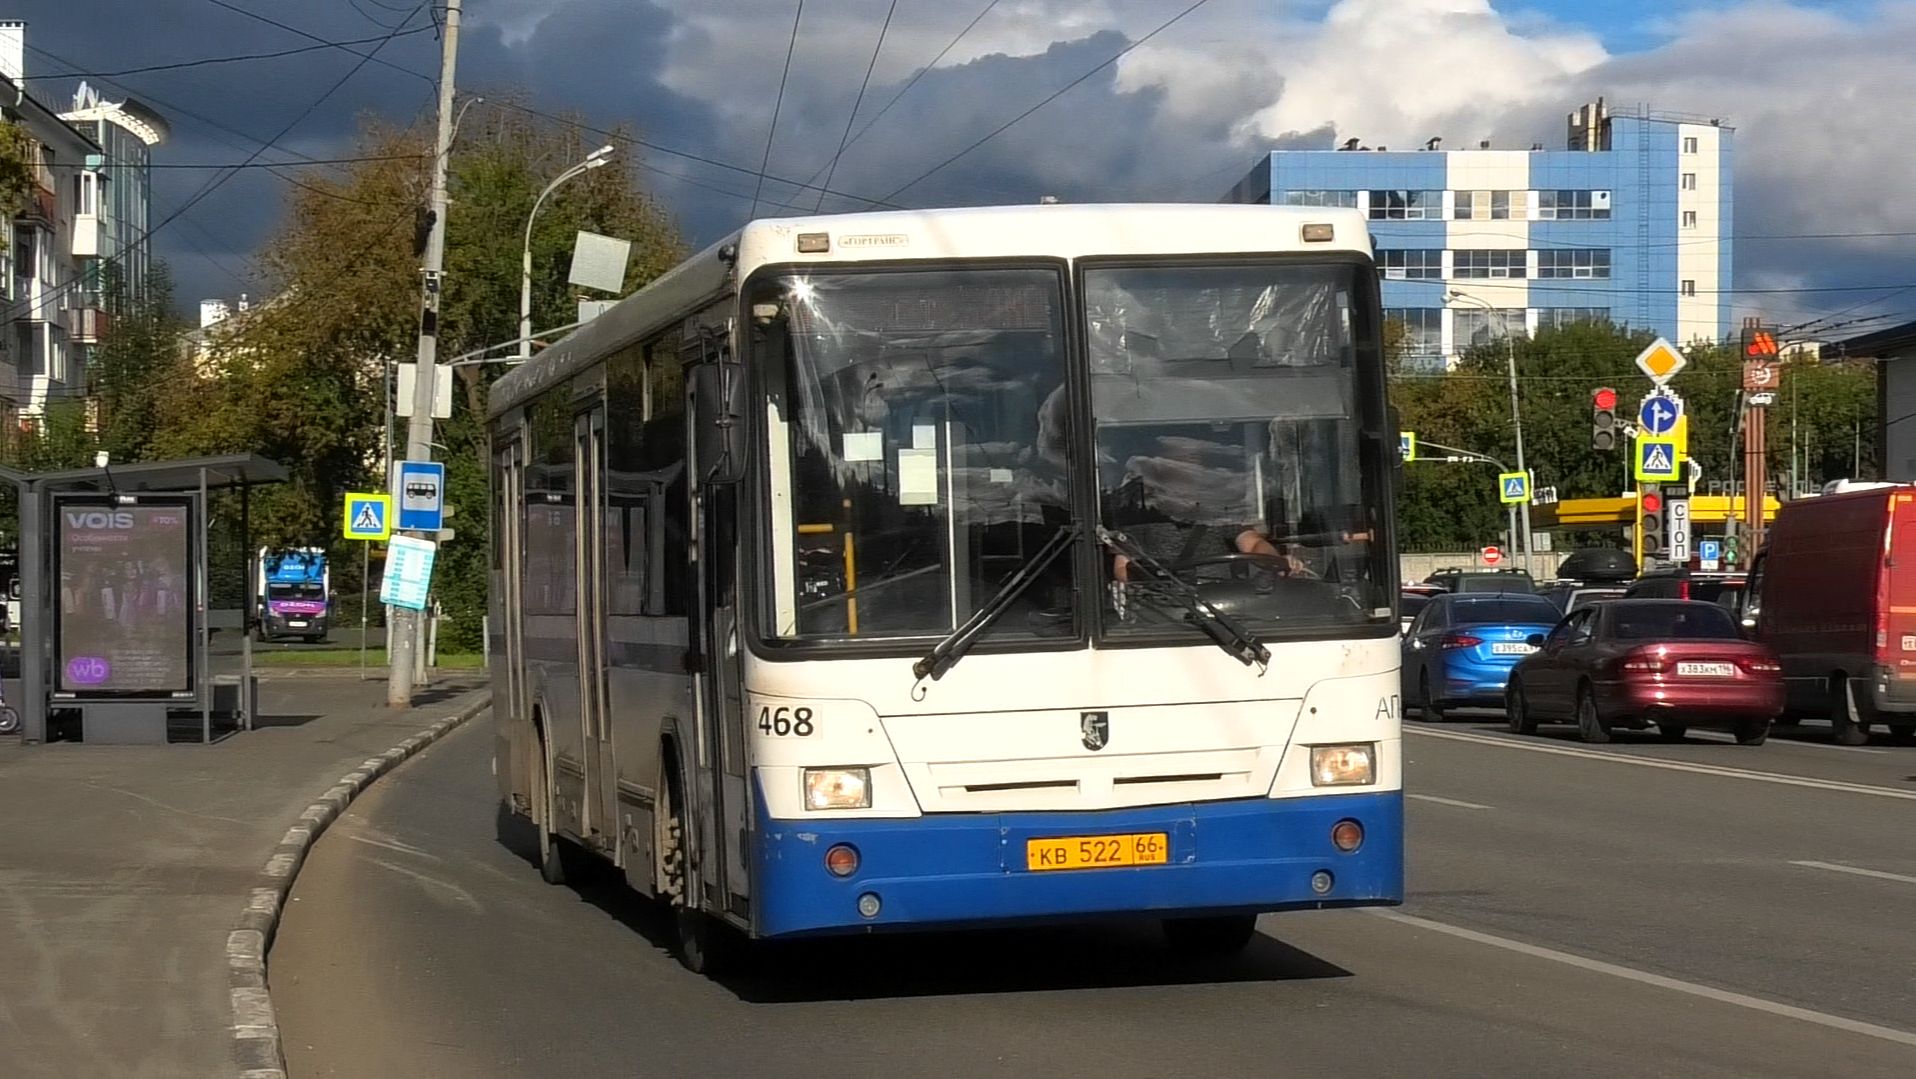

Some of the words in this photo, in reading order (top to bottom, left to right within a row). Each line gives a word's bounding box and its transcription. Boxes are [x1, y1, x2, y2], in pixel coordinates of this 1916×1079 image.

[66, 512, 134, 529] VOIS
[1674, 504, 1686, 557] СТОП
[73, 659, 105, 678] wb
[758, 706, 814, 737] 468
[1040, 848, 1067, 865] КВ
[1080, 840, 1121, 862] 522
[1136, 836, 1157, 853] 66
